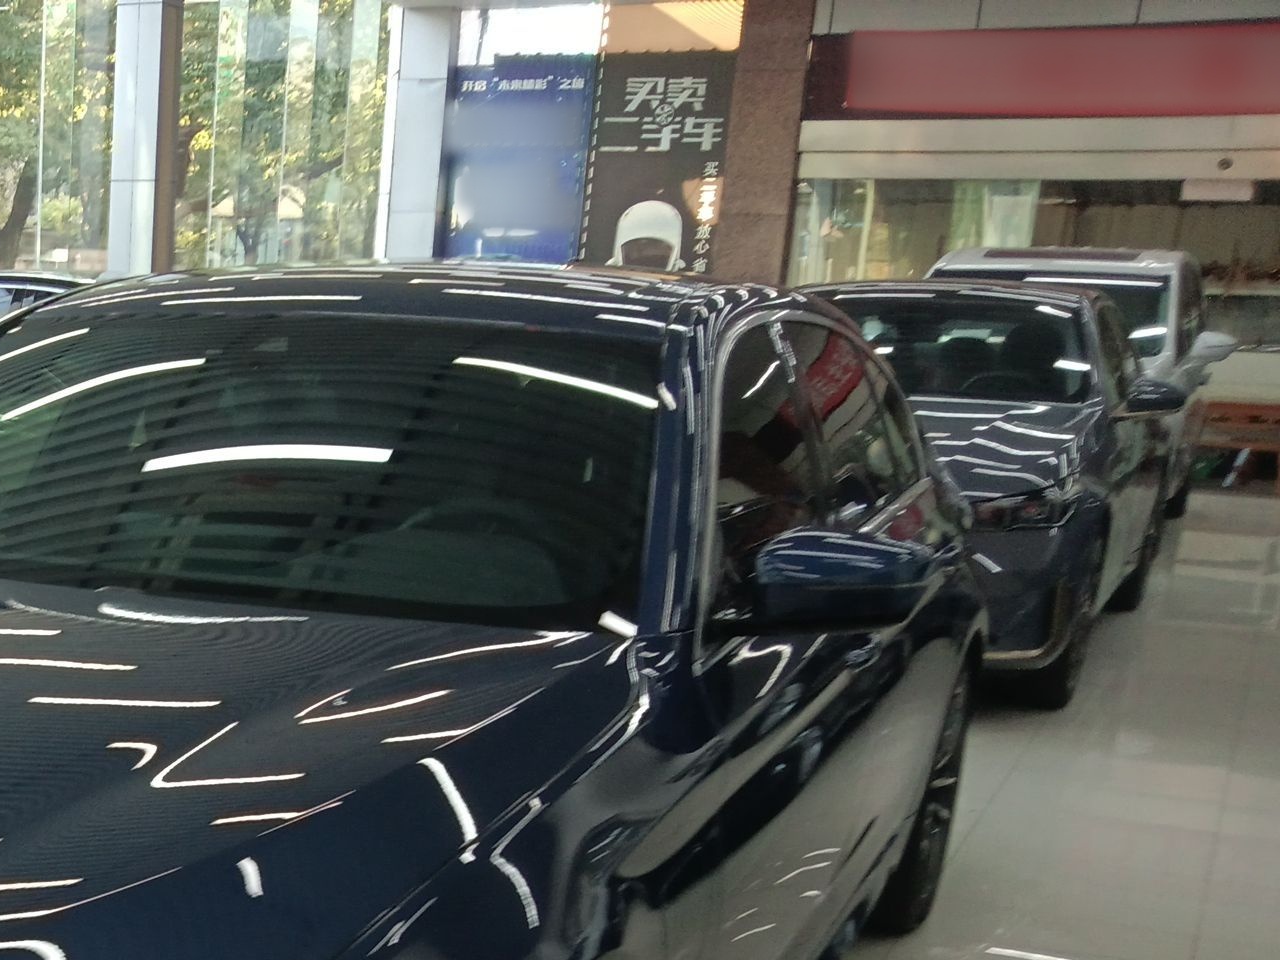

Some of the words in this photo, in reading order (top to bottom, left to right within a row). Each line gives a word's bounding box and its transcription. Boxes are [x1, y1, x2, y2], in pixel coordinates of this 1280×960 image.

[624, 76, 708, 112] 买卖
[599, 116, 725, 152] 二手车
